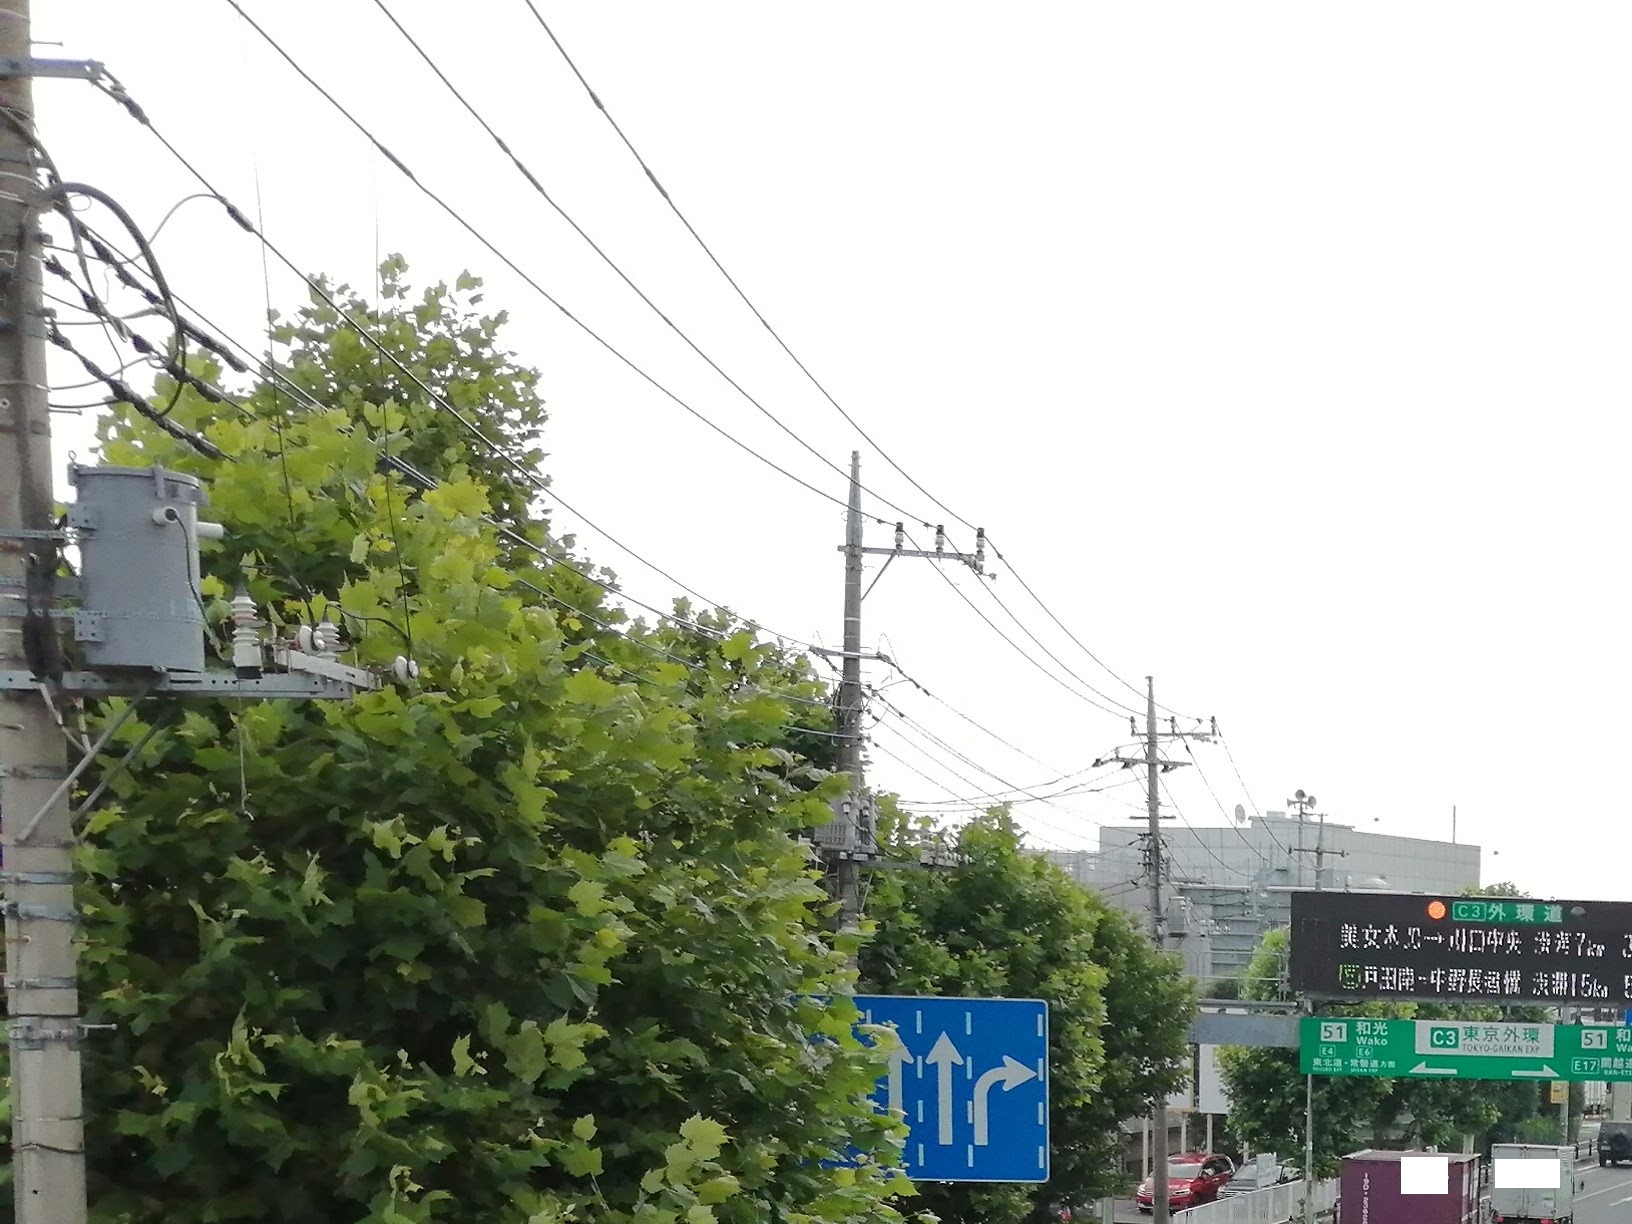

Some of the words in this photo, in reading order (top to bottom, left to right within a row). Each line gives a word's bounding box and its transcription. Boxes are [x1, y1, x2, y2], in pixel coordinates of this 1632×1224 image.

[1458, 906, 1481, 917] C3
[1487, 902, 1563, 922] 外環道
[1323, 1025, 1344, 1039] 51
[1356, 1021, 1388, 1036] 和光
[1462, 1025, 1540, 1044] 東京外環
[1356, 1036, 1388, 1046] Wako
[1432, 1030, 1457, 1045] C3
[1584, 1032, 1604, 1046] 51
[1463, 1043, 1522, 1053] TOKYO-GAIKAN
[1525, 1046, 1540, 1054] EXP
[1574, 1060, 1597, 1072] E17
